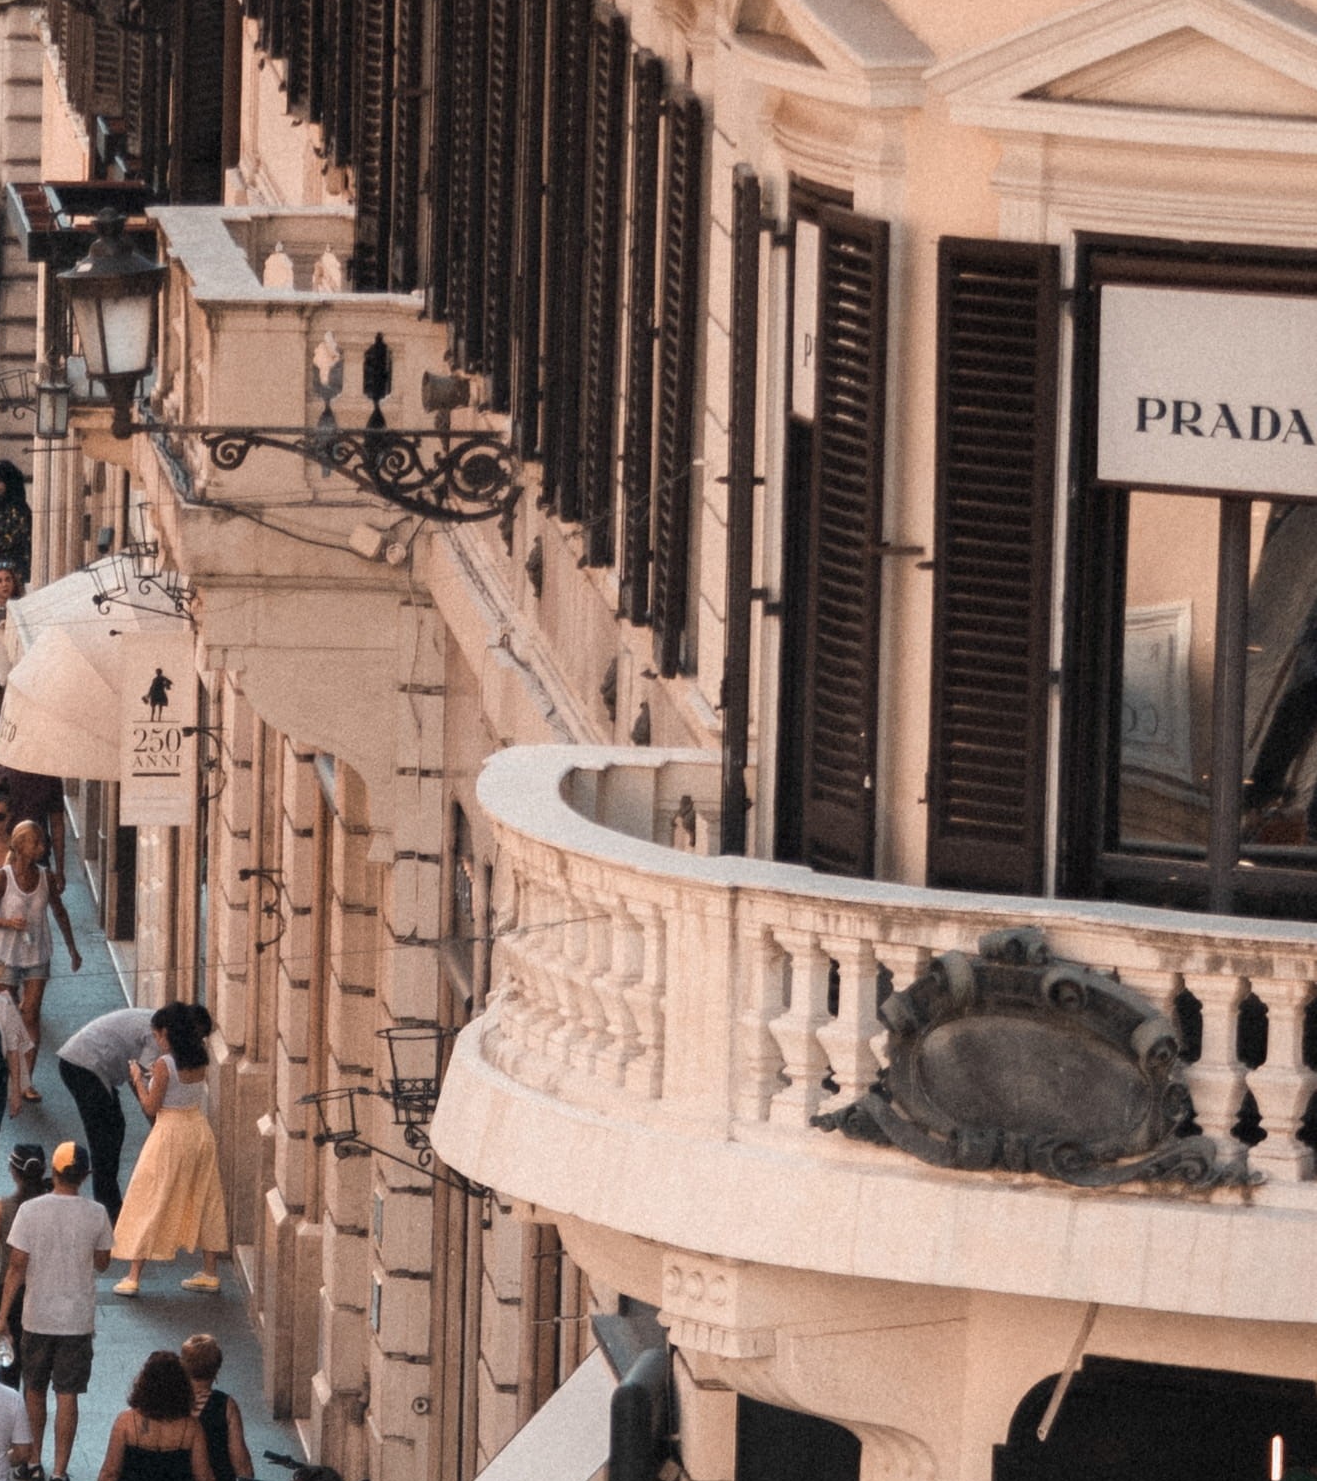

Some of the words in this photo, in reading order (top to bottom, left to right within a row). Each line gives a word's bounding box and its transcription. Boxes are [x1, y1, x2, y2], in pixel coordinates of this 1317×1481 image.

[1135, 396, 1316, 446] PRADA
[132, 726, 182, 753] 250
[132, 754, 181, 768] ANNI
